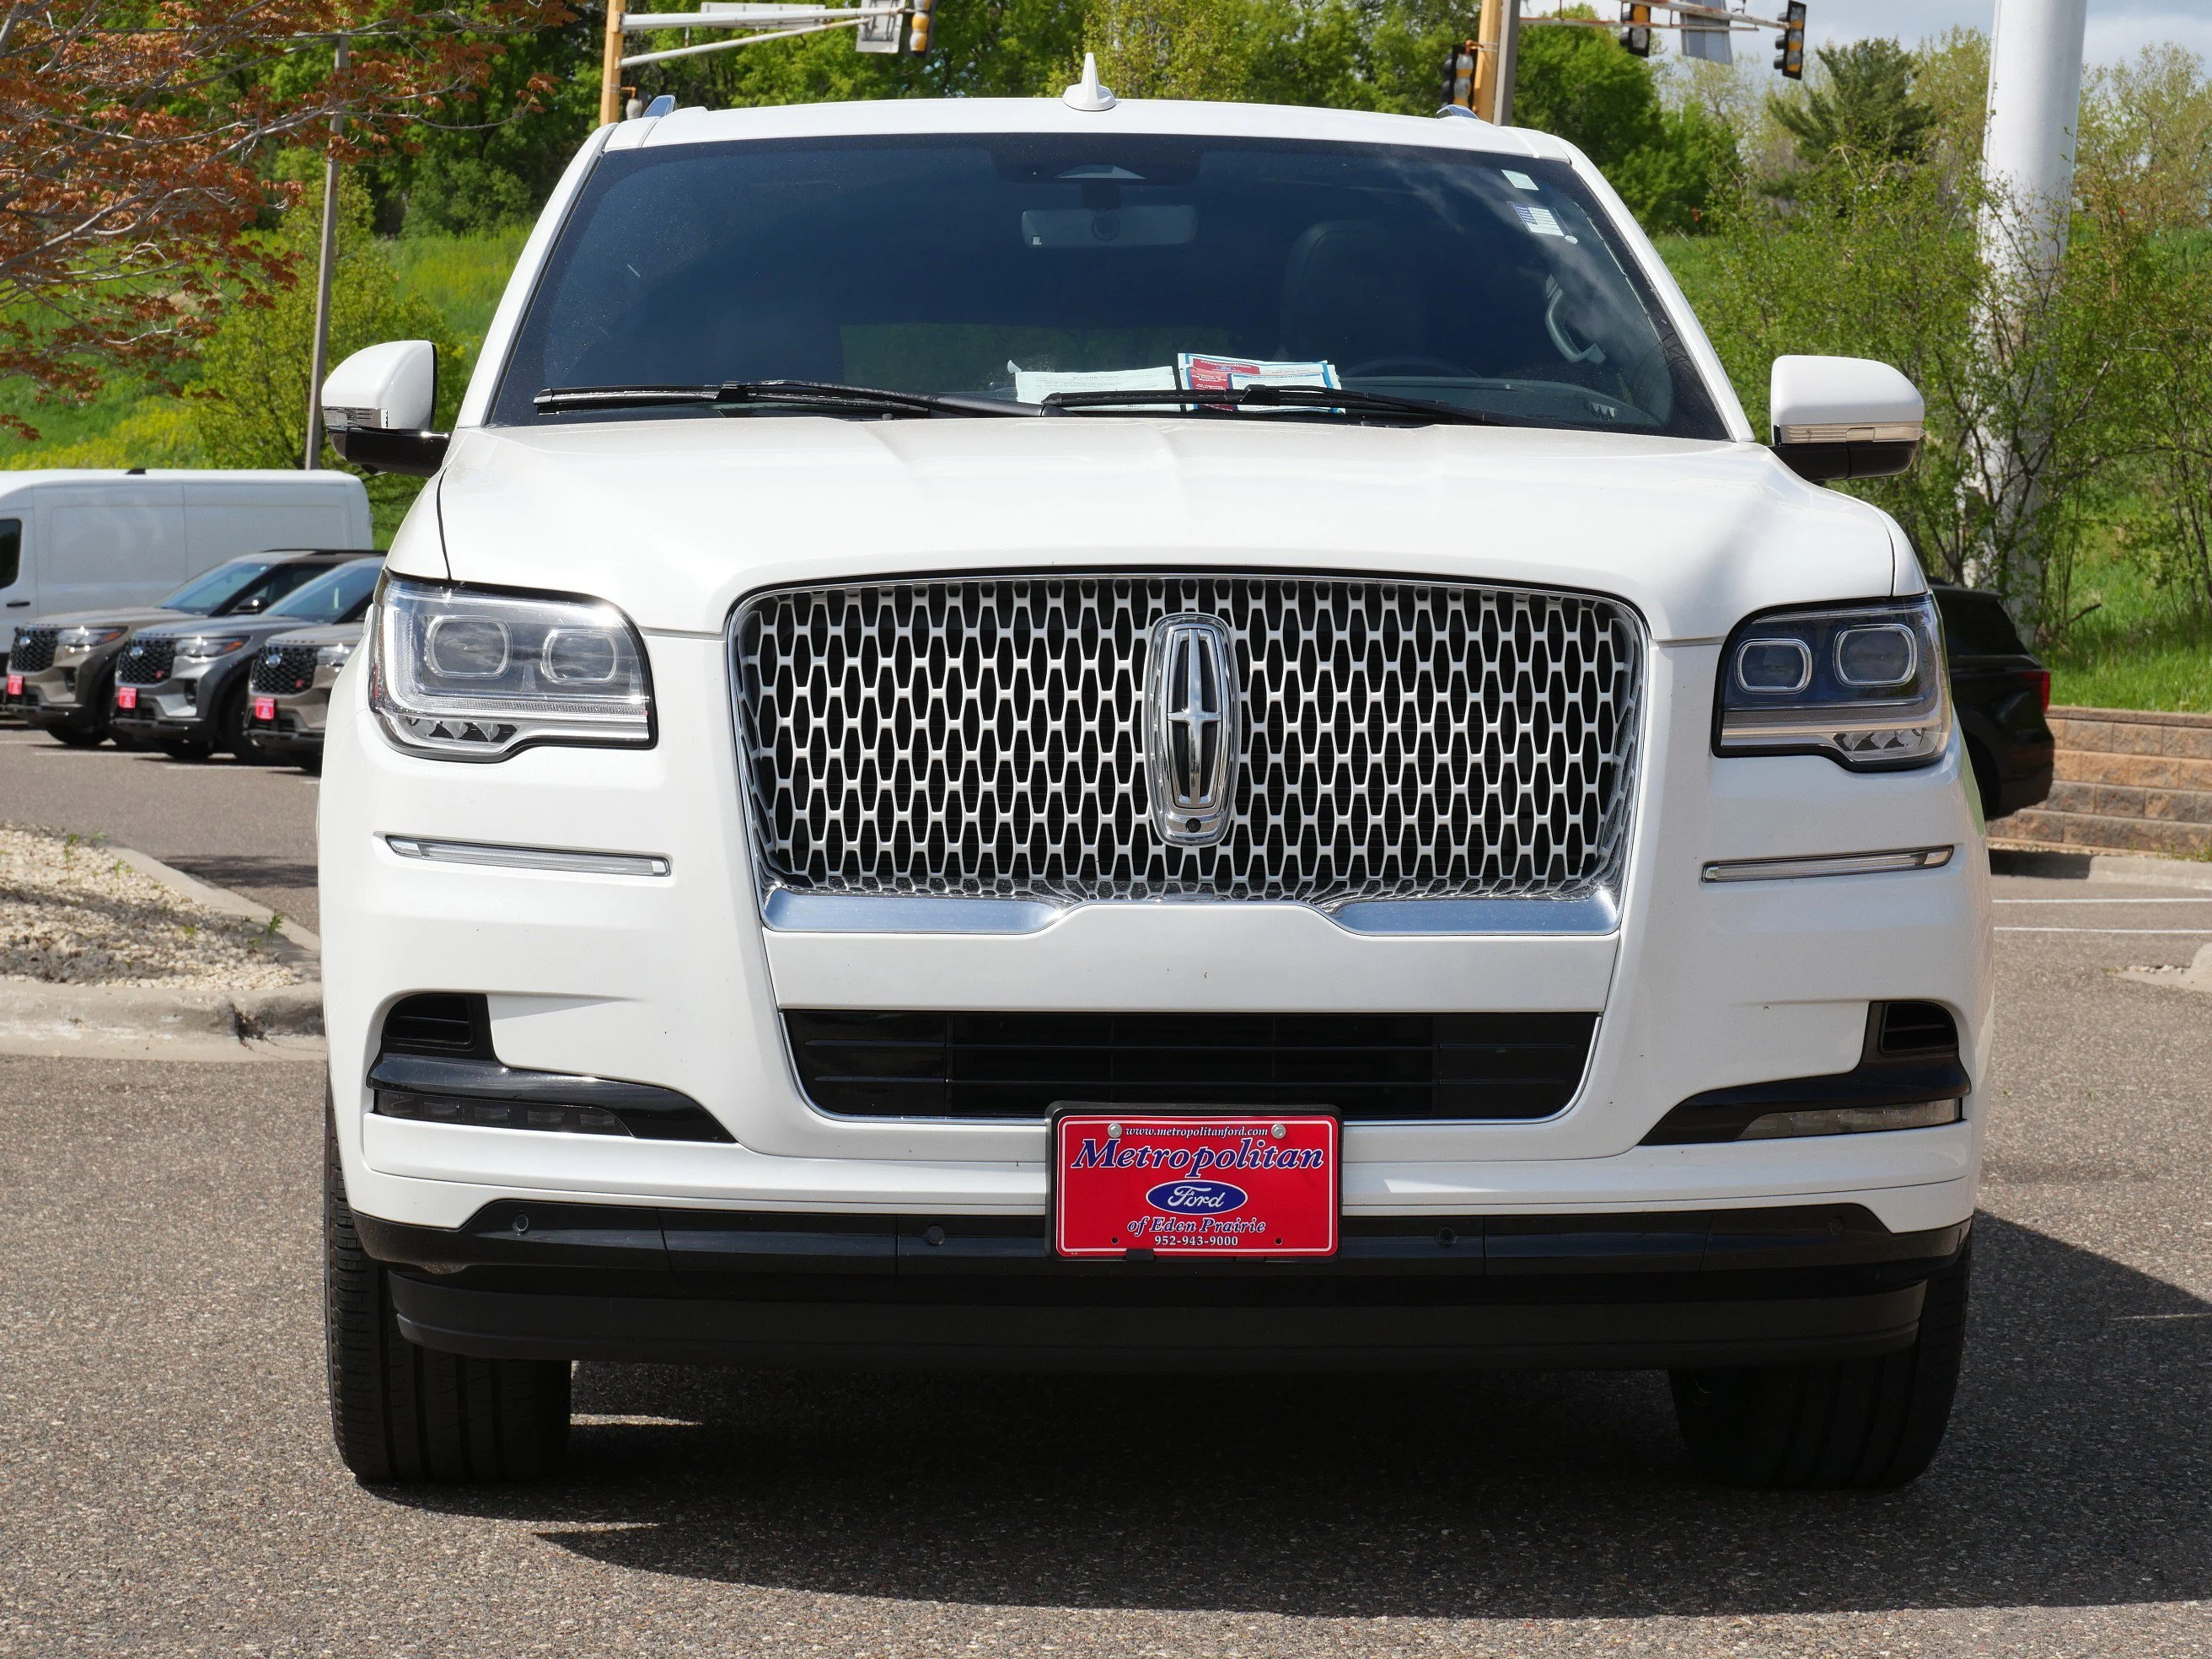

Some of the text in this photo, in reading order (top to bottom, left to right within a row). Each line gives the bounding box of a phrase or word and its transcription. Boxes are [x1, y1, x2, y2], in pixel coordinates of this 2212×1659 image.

[1126, 1125, 1268, 1139] www.metropolitanford.com
[1071, 1138, 1324, 1178] Metropolitan
[1168, 1185, 1225, 1208] Ford
[1127, 1216, 1266, 1237] of Eden Prairie
[1154, 1236, 1238, 1247] 952-943-9000
